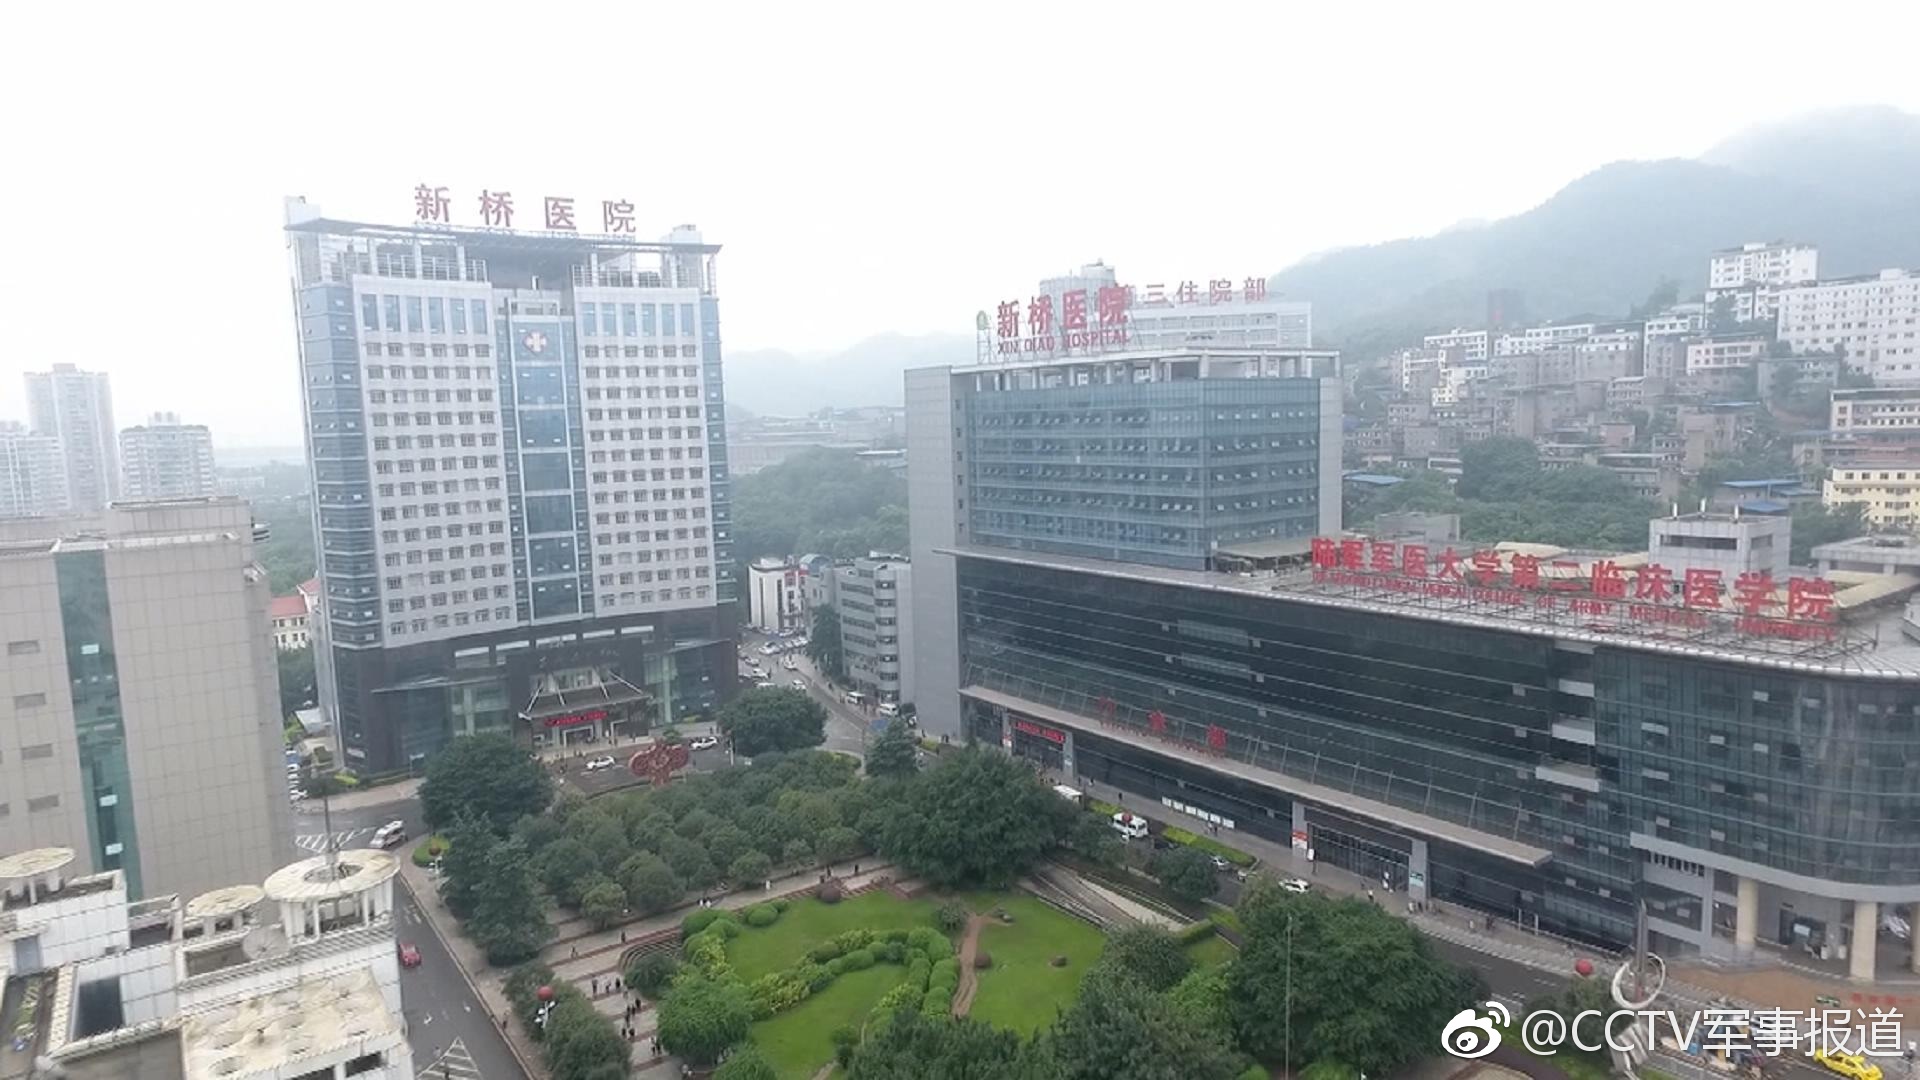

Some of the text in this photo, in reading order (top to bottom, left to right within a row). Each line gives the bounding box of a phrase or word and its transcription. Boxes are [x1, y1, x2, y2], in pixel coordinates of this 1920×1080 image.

[414, 183, 636, 233] 新桥医院
[997, 286, 1128, 338] 新桥医院
[1064, 329, 1129, 350] HOSPITAL
[1311, 538, 1835, 620] 陆军军医大学第二临床医学院
